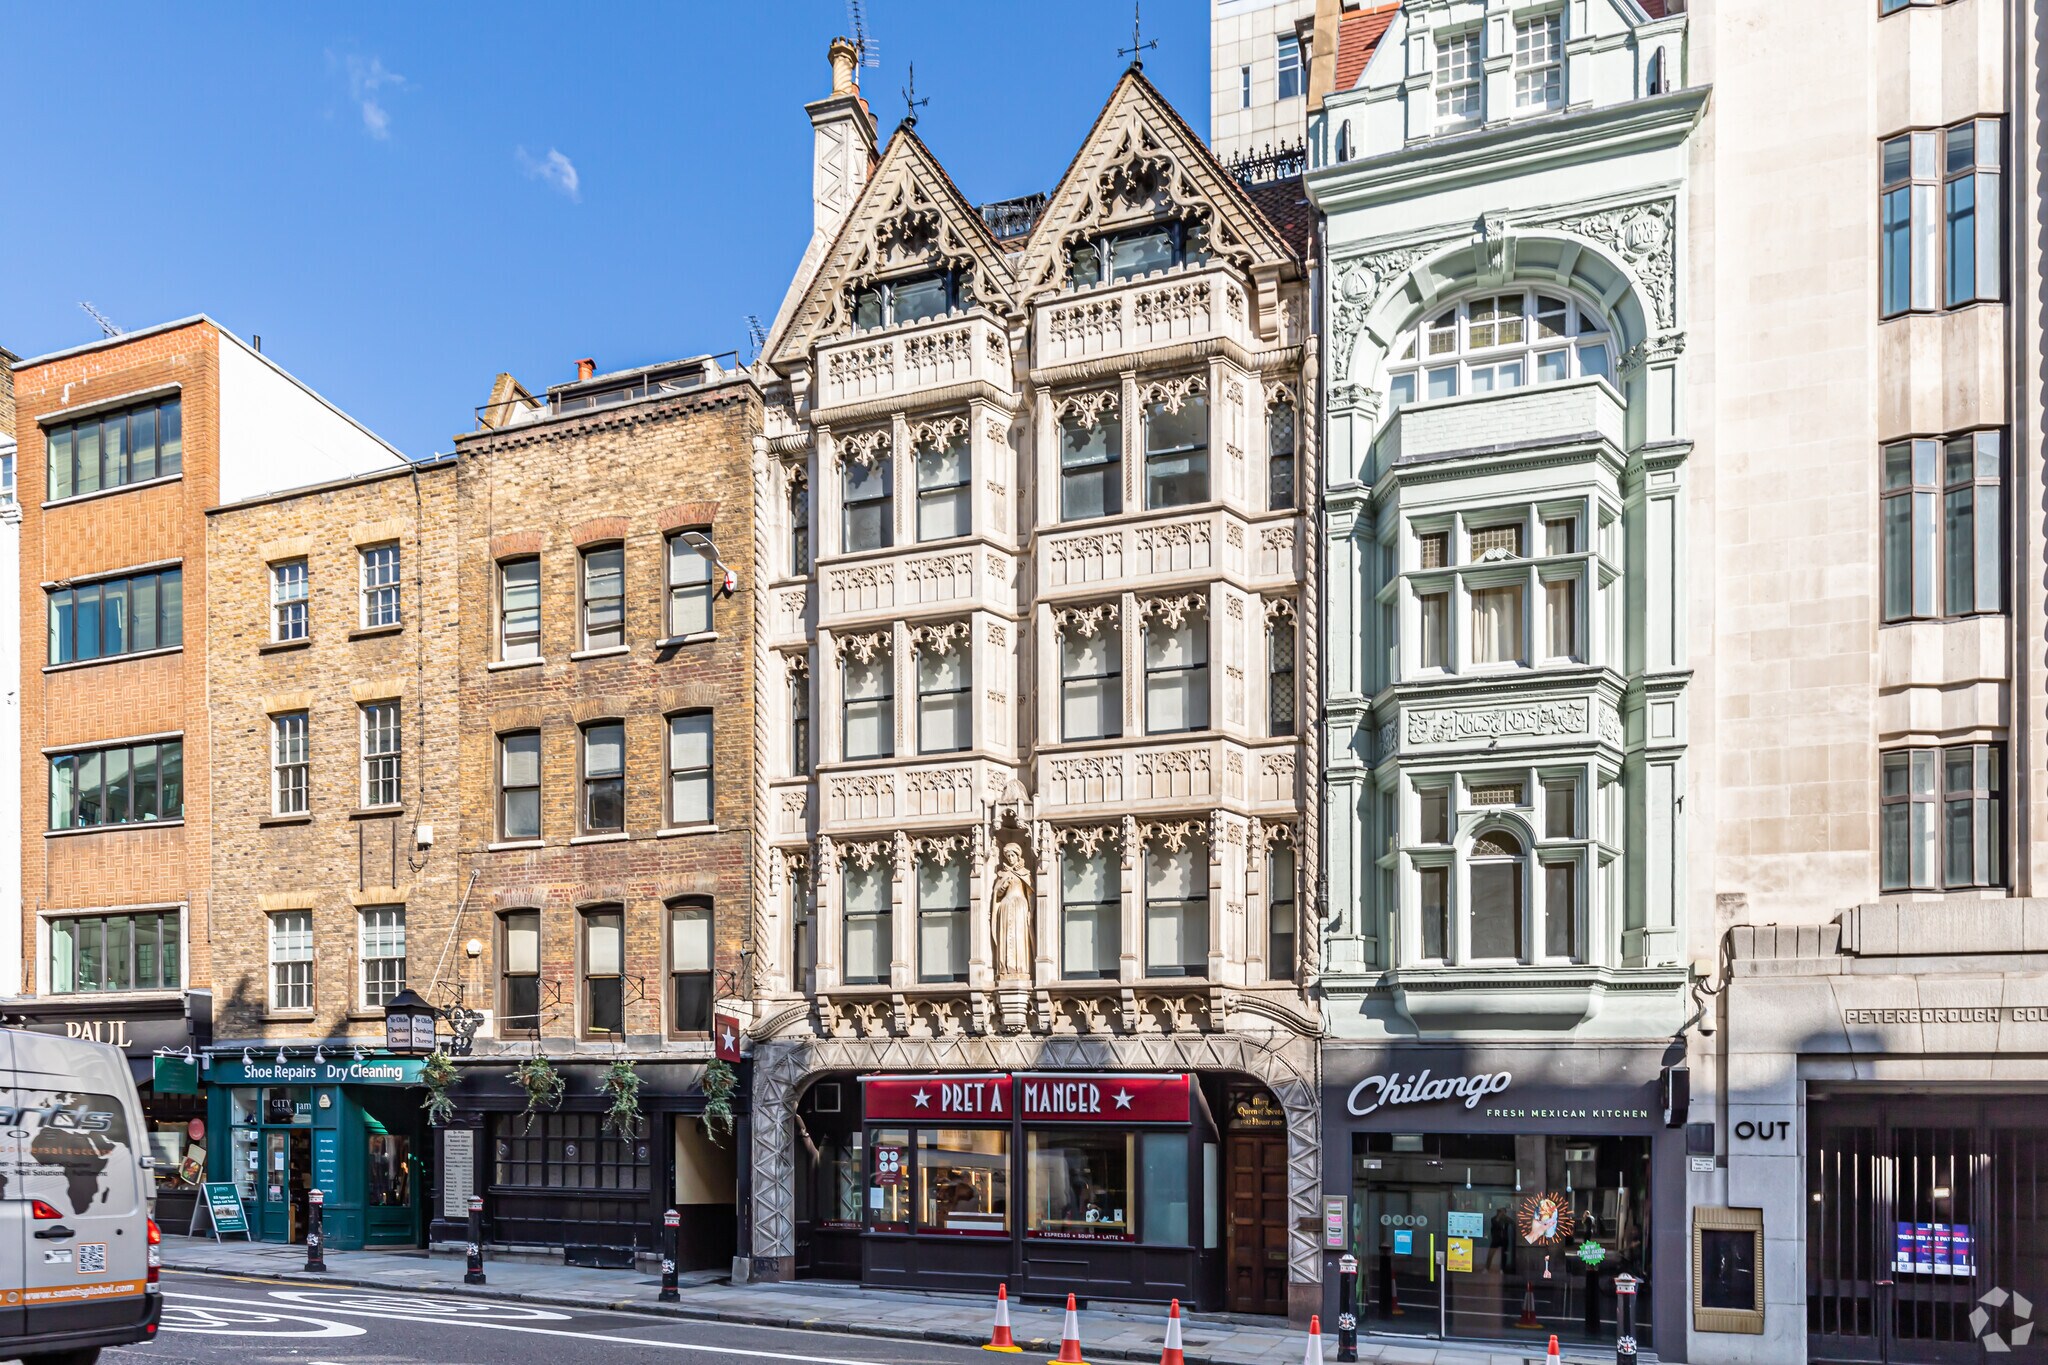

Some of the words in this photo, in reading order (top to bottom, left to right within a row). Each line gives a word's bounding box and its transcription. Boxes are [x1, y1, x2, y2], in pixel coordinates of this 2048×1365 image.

[1845, 1009, 2000, 1024] PETERBOROUGH
[65, 1020, 133, 1048] PAUL
[244, 1064, 273, 1079] Shoe
[274, 1064, 317, 1081] Repairs
[327, 1064, 348, 1081] Dry
[350, 1063, 403, 1082] Cleaning
[941, 1082, 985, 1112] PRET
[989, 1082, 1003, 1113] A
[1024, 1082, 1100, 1113] MANGER
[1347, 1069, 1512, 1116] Chilango
[272, 1099, 292, 1108] CITY
[1486, 1109, 1525, 1118] FRESH
[1531, 1109, 1586, 1118] MEXICAN
[1592, 1109, 1648, 1119] KITCHEN
[1735, 1121, 1790, 1141] OUT
